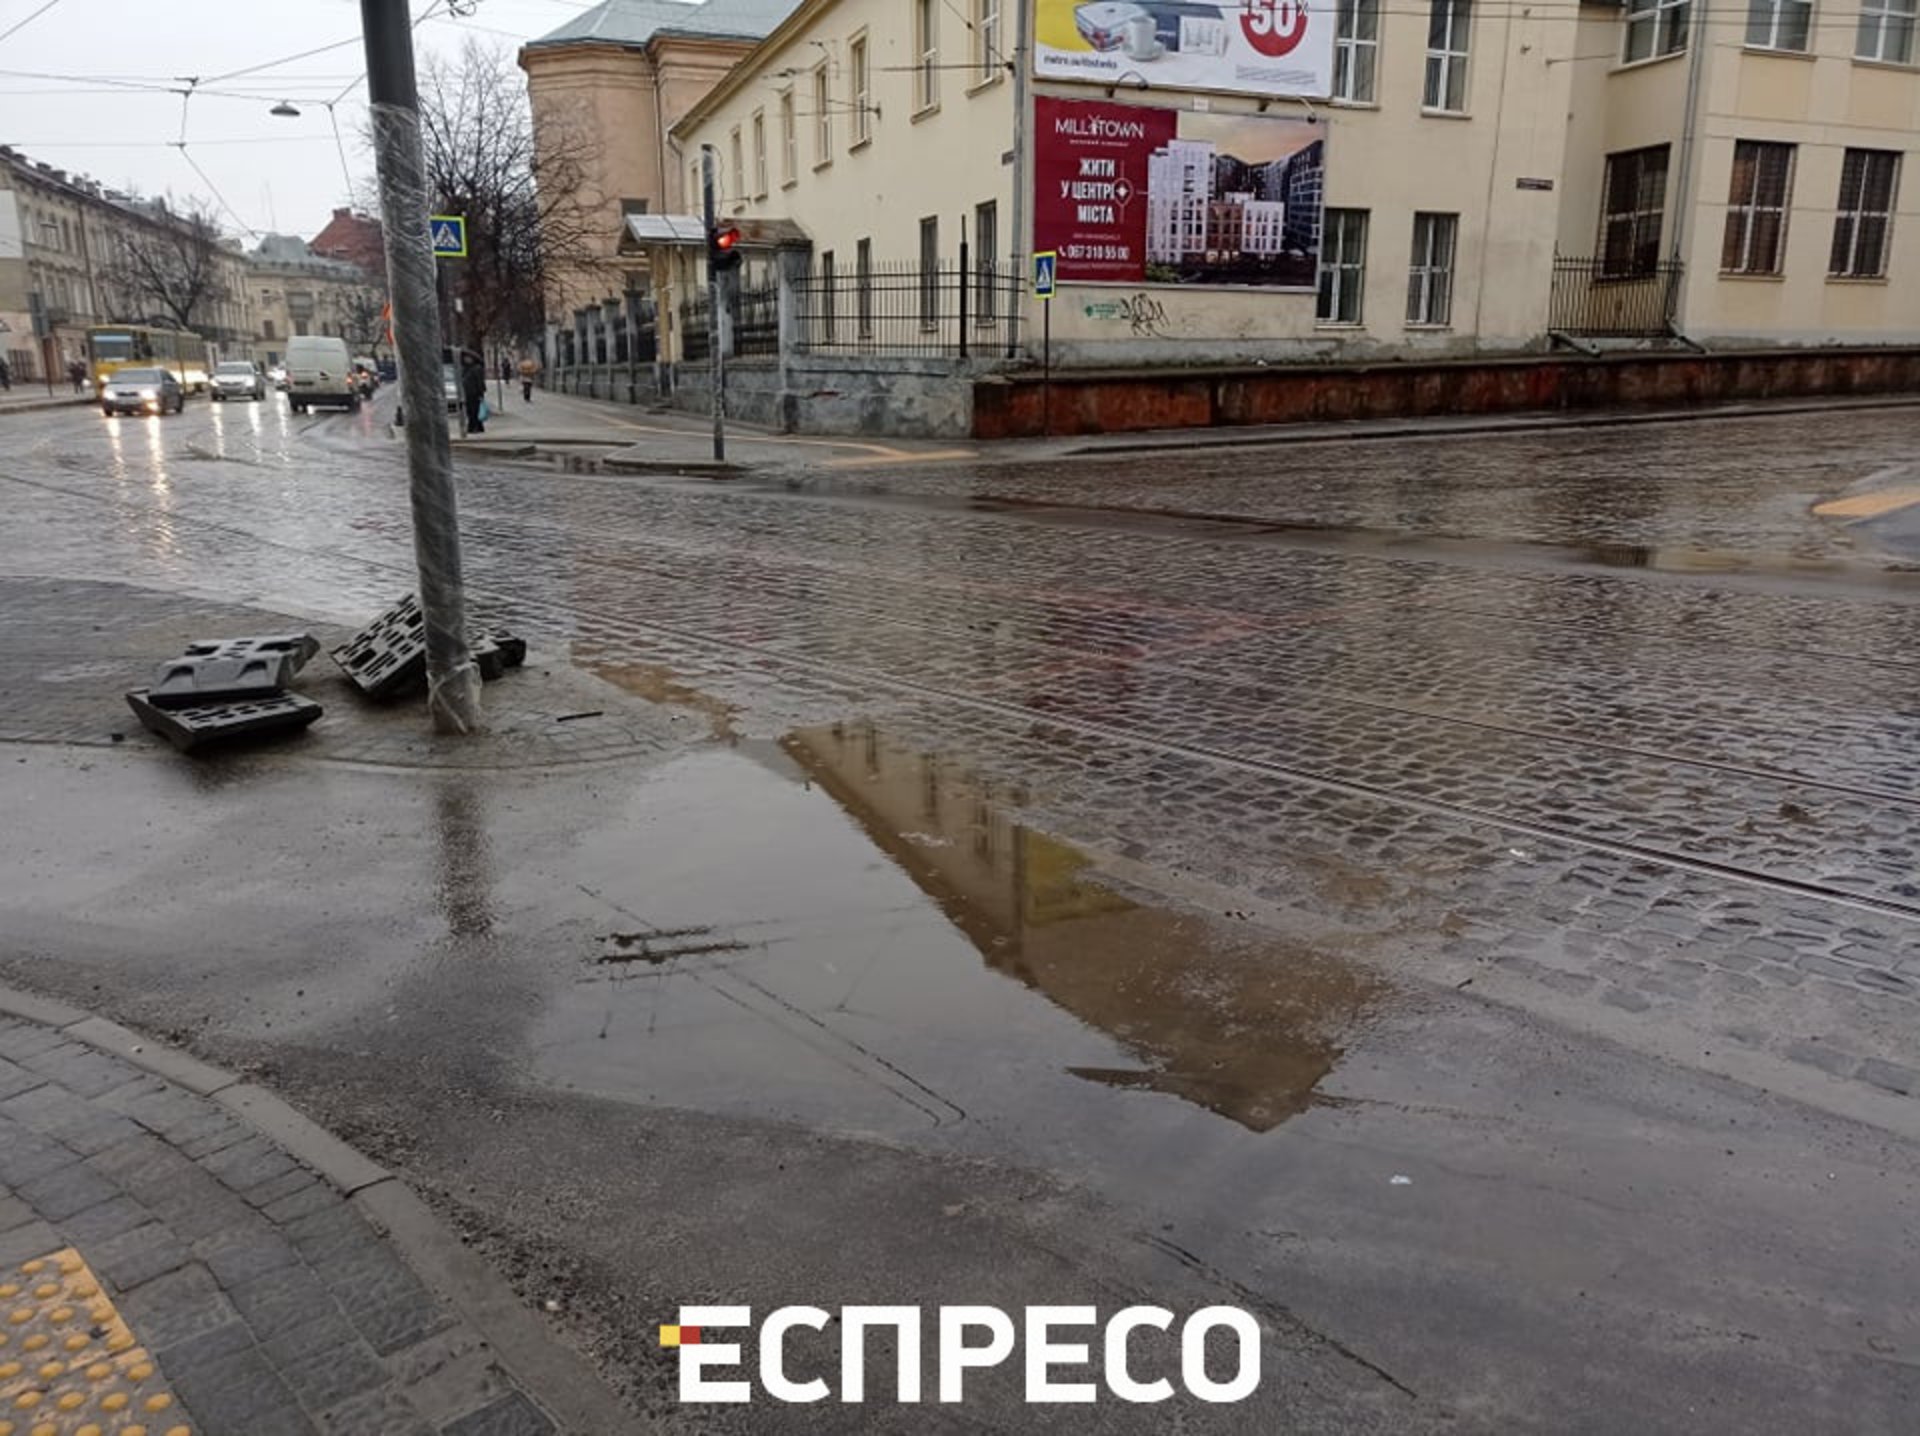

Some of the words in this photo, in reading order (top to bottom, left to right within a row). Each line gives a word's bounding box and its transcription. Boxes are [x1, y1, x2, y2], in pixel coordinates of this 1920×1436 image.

[1079, 158, 1115, 177] ЖИТИ
[1061, 180, 1070, 198] У
[1071, 181, 1116, 200] ЦЕНТРІ
[1077, 205, 1115, 224] МІСТА
